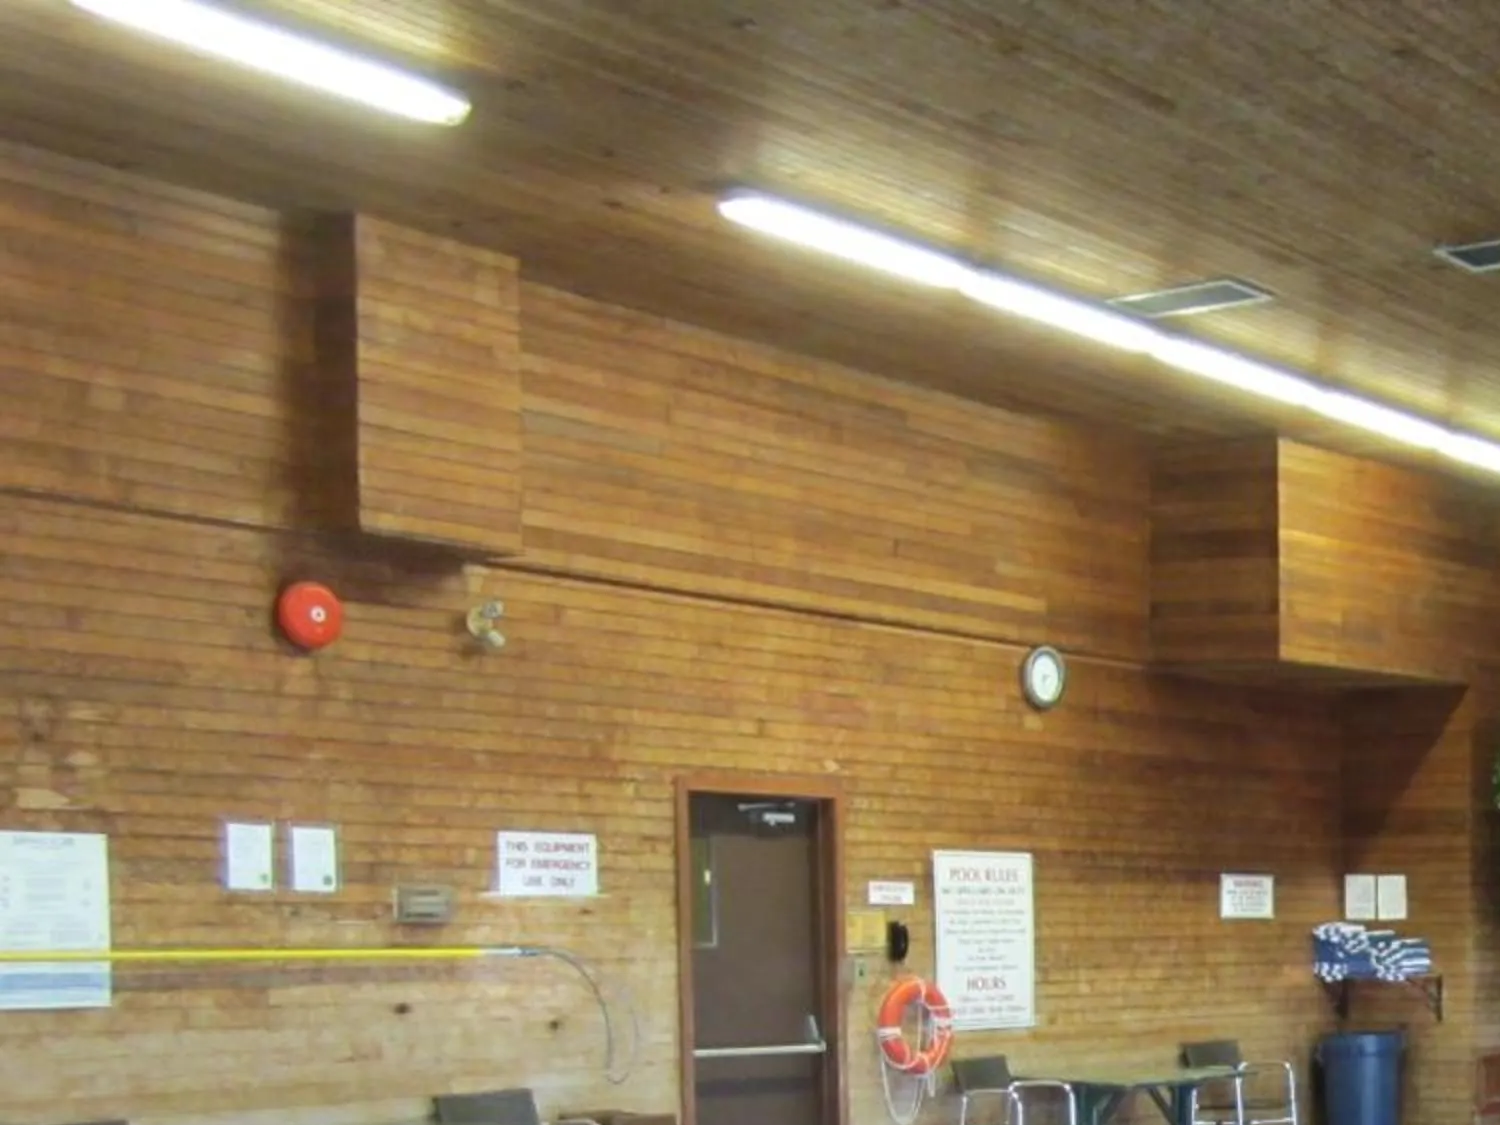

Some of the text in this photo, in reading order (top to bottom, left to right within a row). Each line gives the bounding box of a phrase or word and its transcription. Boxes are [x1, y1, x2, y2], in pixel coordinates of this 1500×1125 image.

[505, 840, 590, 853] THIS EQUIPMENT
[505, 858, 591, 870] FOR EMERGENCY
[948, 867, 981, 882] POOL
[549, 876, 575, 888] ONLY
[966, 975, 1007, 992] HOURS
